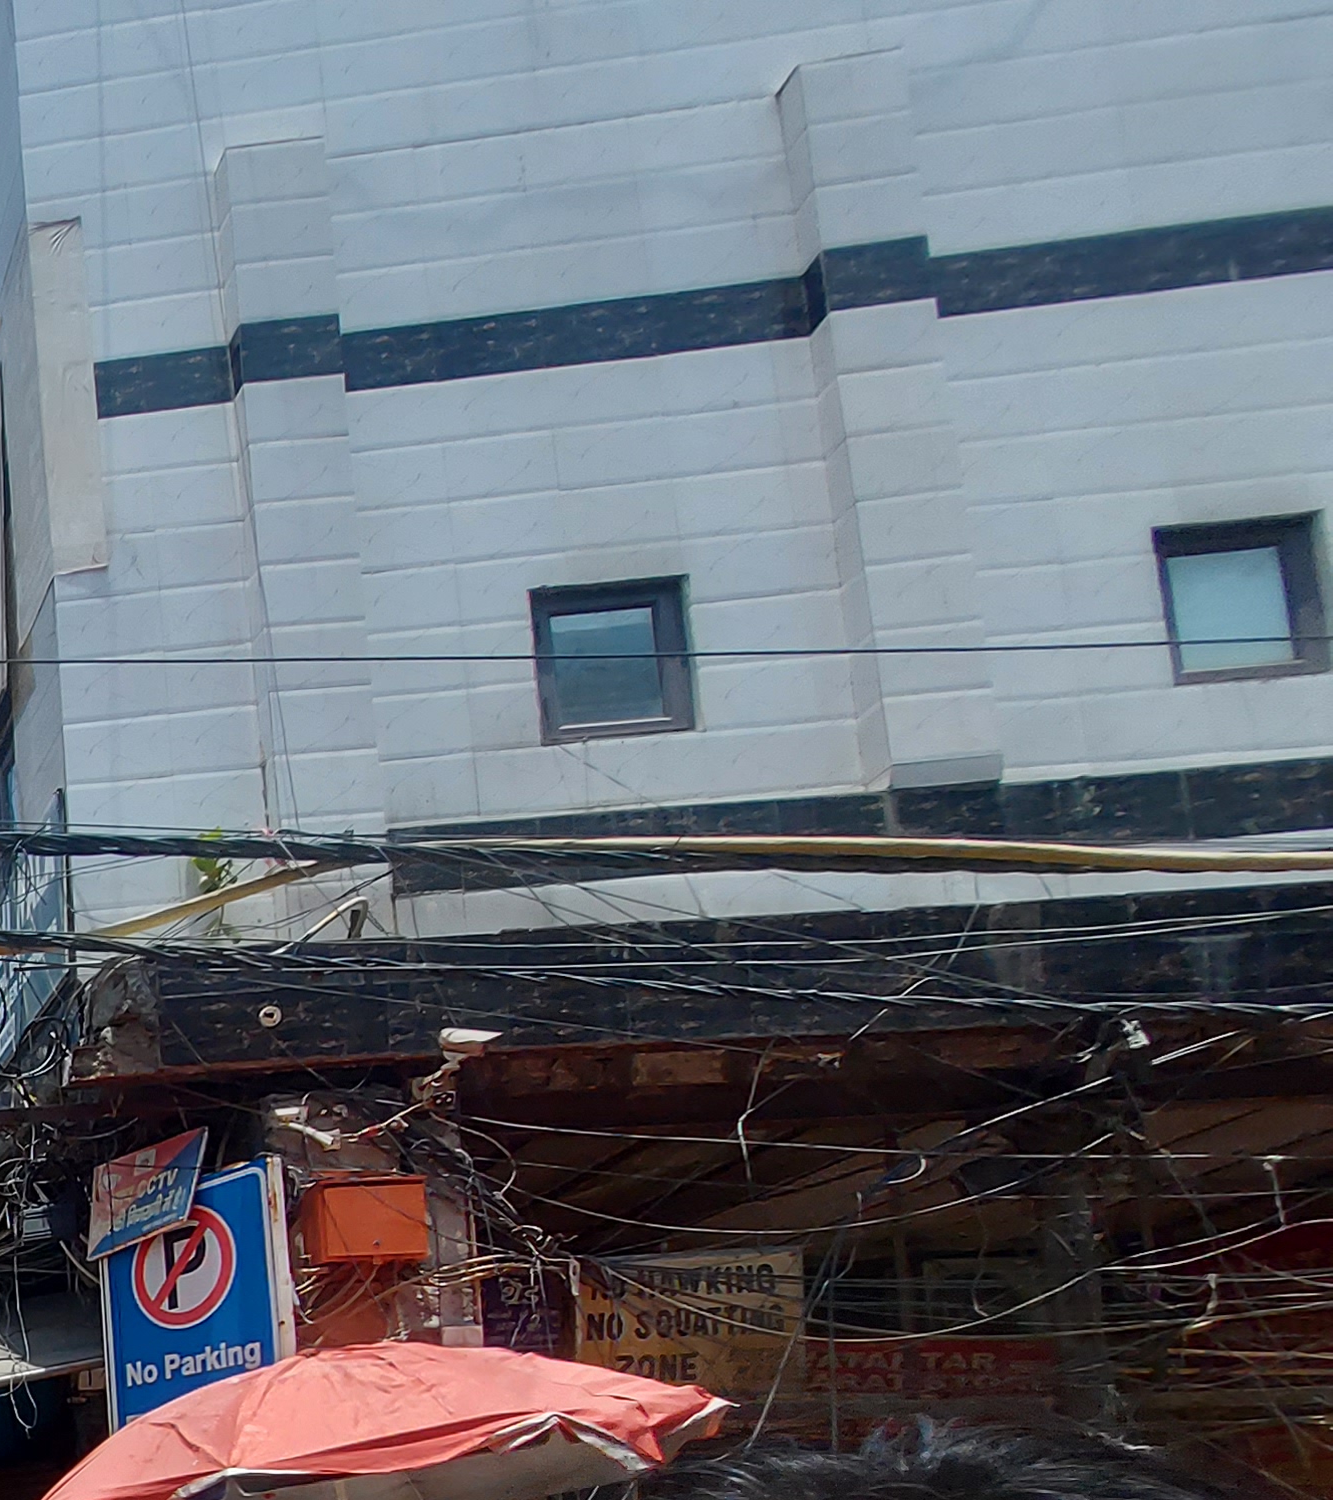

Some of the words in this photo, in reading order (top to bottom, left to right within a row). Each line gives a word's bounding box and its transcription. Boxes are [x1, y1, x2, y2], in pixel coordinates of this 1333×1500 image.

[586, 1312, 624, 1341] NO
[125, 1360, 158, 1387] No
[164, 1341, 262, 1380] Parking
[615, 1351, 700, 1381] ZONE
